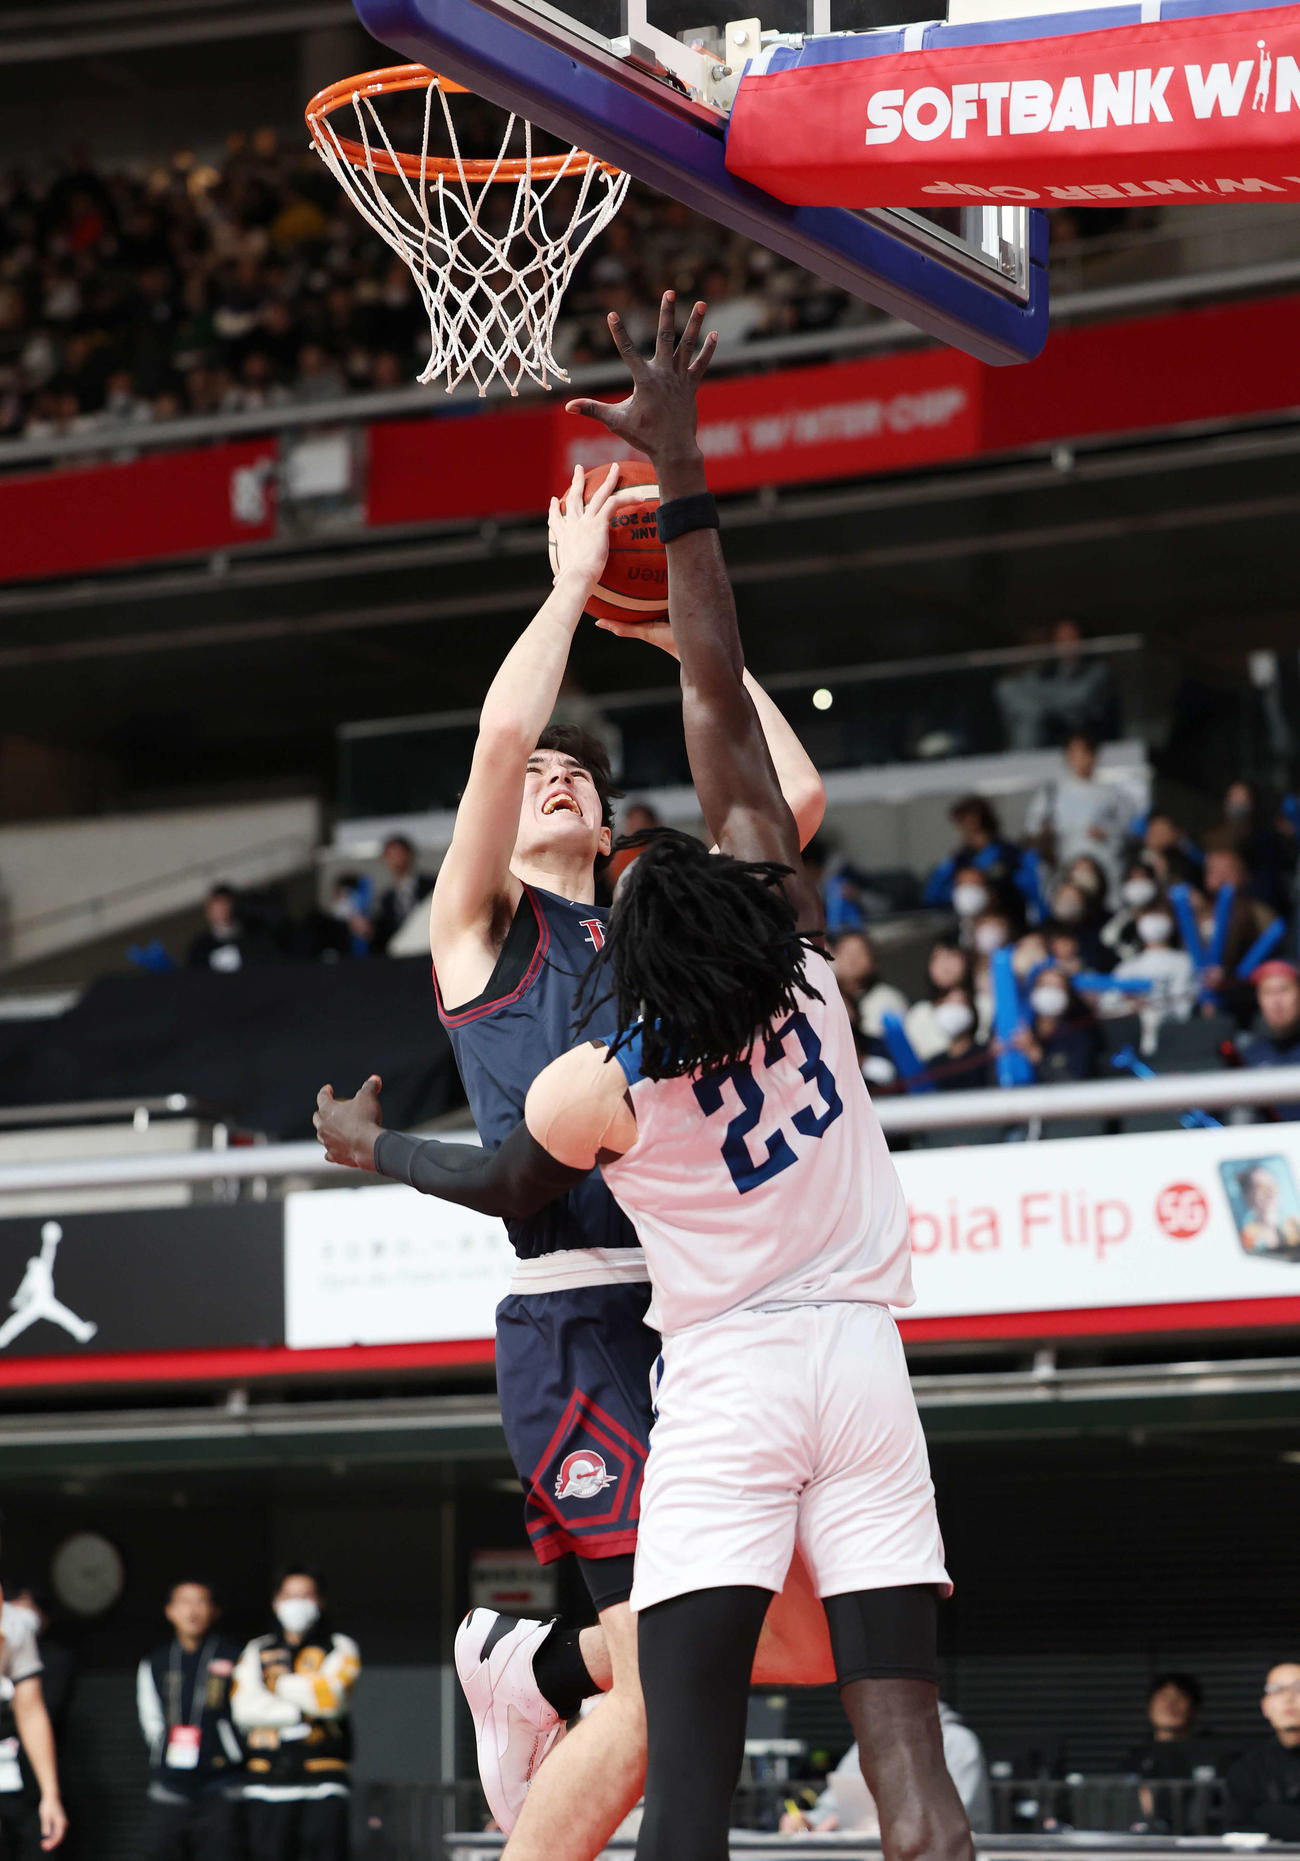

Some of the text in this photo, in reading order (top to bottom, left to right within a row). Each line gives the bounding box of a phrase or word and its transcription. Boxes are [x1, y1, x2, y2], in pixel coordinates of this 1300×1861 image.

[865, 66, 1175, 146] SOFTBANK
[921, 178, 1287, 200] WINTER CUP
[611, 512, 657, 528] UP 202
[631, 527, 657, 541] ANK
[628, 566, 667, 584] lten
[692, 1011, 843, 1195] 23
[907, 1197, 1001, 1254] bia
[1020, 1192, 1132, 1260] Flip
